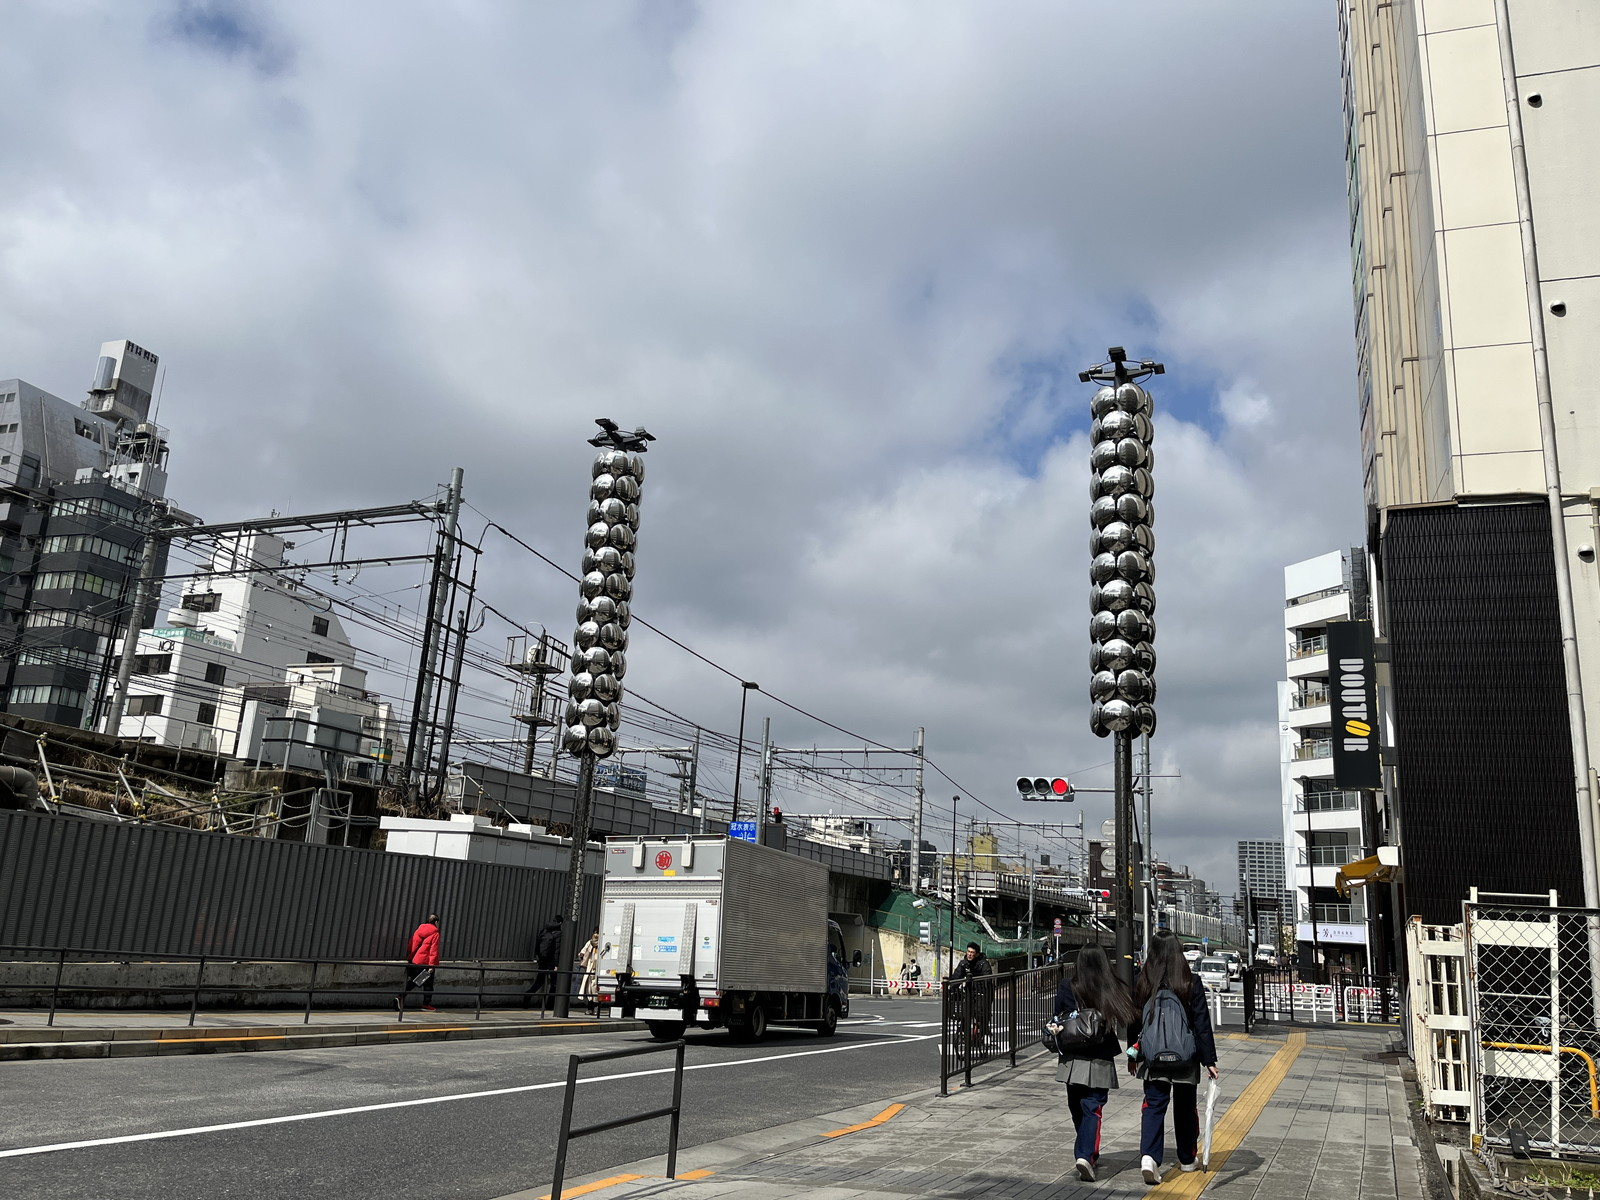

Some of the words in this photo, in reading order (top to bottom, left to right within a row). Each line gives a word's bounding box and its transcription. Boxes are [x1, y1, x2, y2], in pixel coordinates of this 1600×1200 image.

[1339, 658, 1371, 752] DOUTOR
[730, 822, 755, 831] 冠水表示
